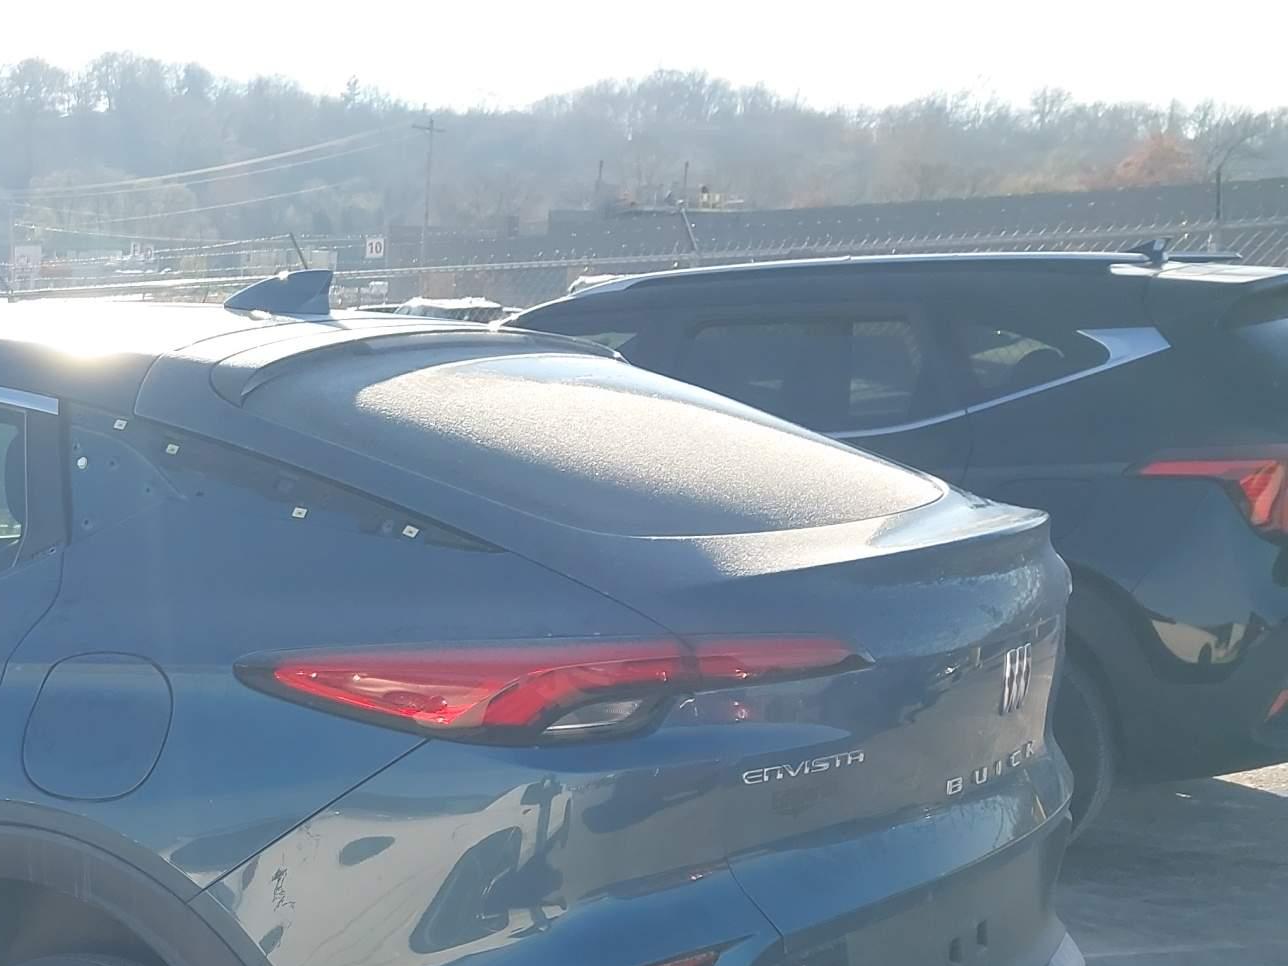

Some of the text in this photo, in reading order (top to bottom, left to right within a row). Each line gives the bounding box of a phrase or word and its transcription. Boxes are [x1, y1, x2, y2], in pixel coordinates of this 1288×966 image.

[367, 241, 382, 254] 10
[742, 750, 865, 785] ENVISTA
[945, 740, 1036, 796] BUICK
